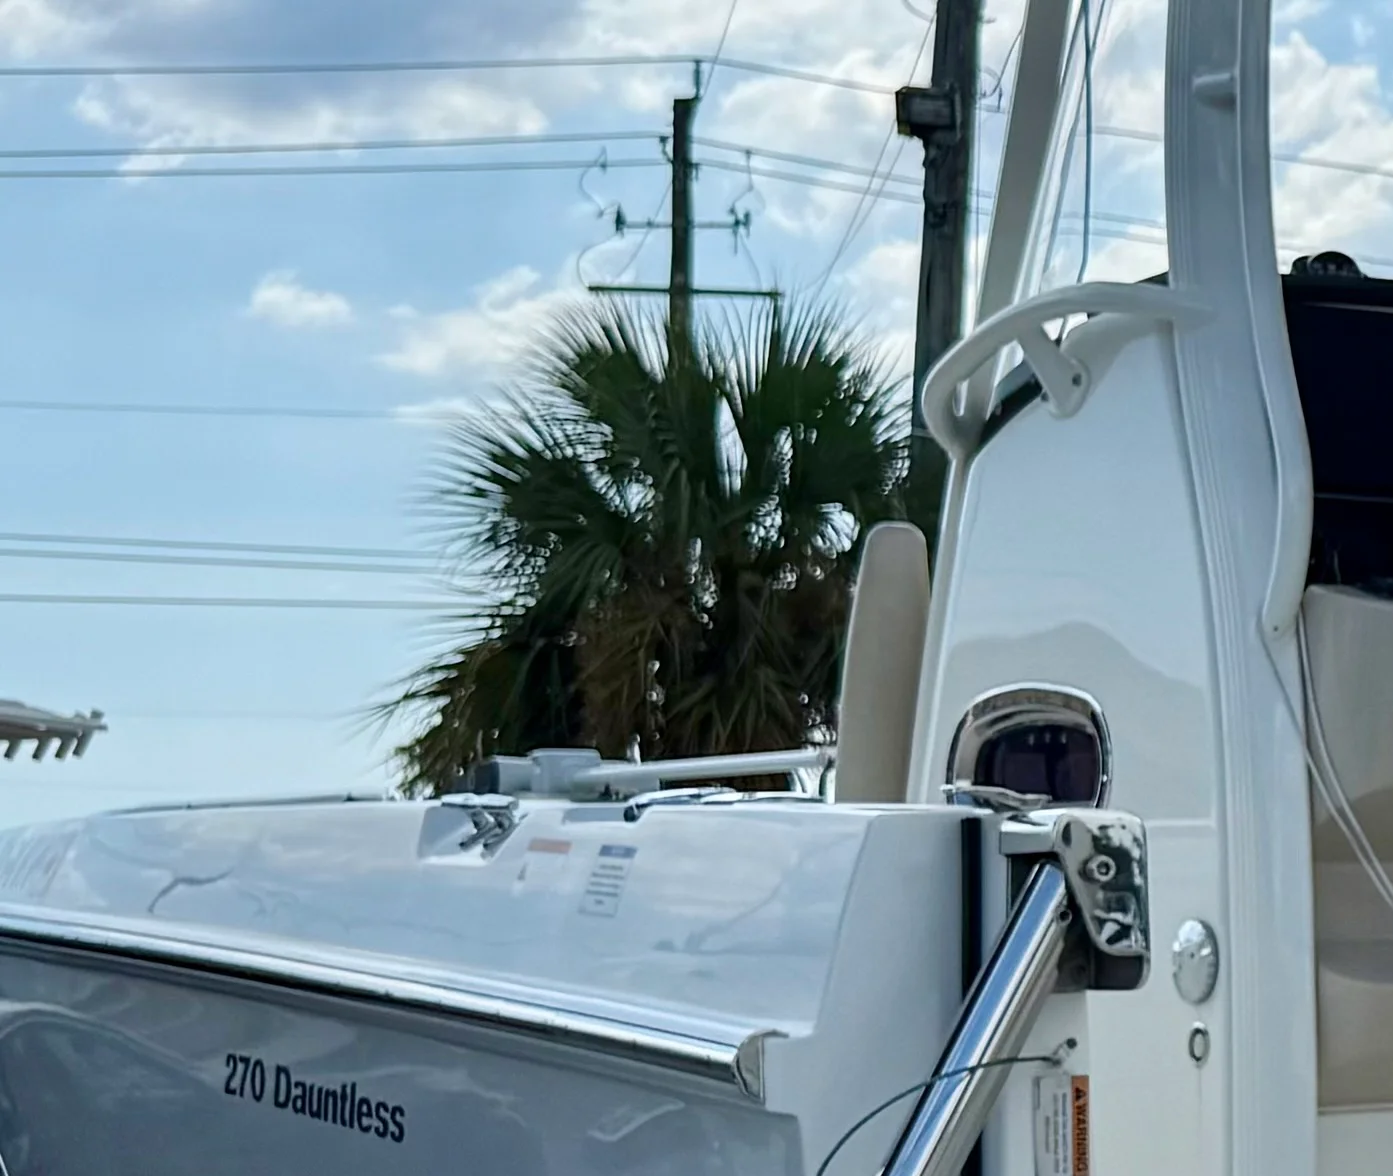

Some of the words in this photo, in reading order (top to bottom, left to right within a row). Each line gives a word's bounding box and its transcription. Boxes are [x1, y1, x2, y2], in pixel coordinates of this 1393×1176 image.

[225, 1053, 266, 1102] 270
[273, 1064, 405, 1143] Dauntless
[1076, 1103, 1088, 1172] WARNING
